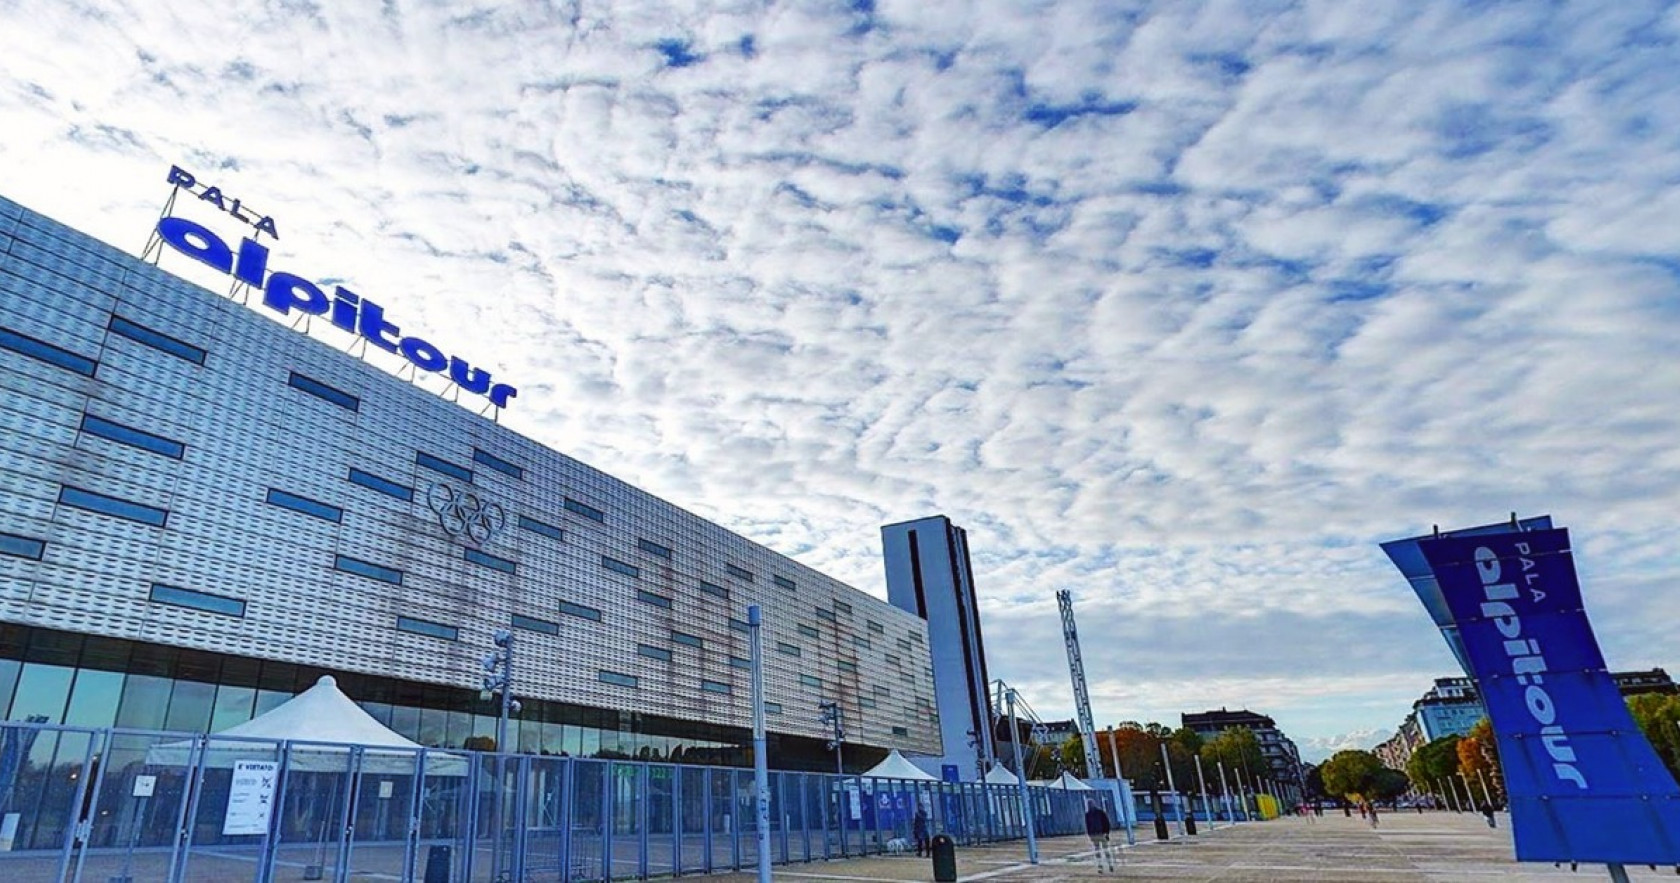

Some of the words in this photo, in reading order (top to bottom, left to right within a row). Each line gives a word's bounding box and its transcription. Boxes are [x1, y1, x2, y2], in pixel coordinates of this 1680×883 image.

[167, 164, 279, 239] PALA
[157, 217, 517, 408] alpitour
[1514, 542, 1546, 603] PALA
[1474, 546, 1588, 789] alpitour
